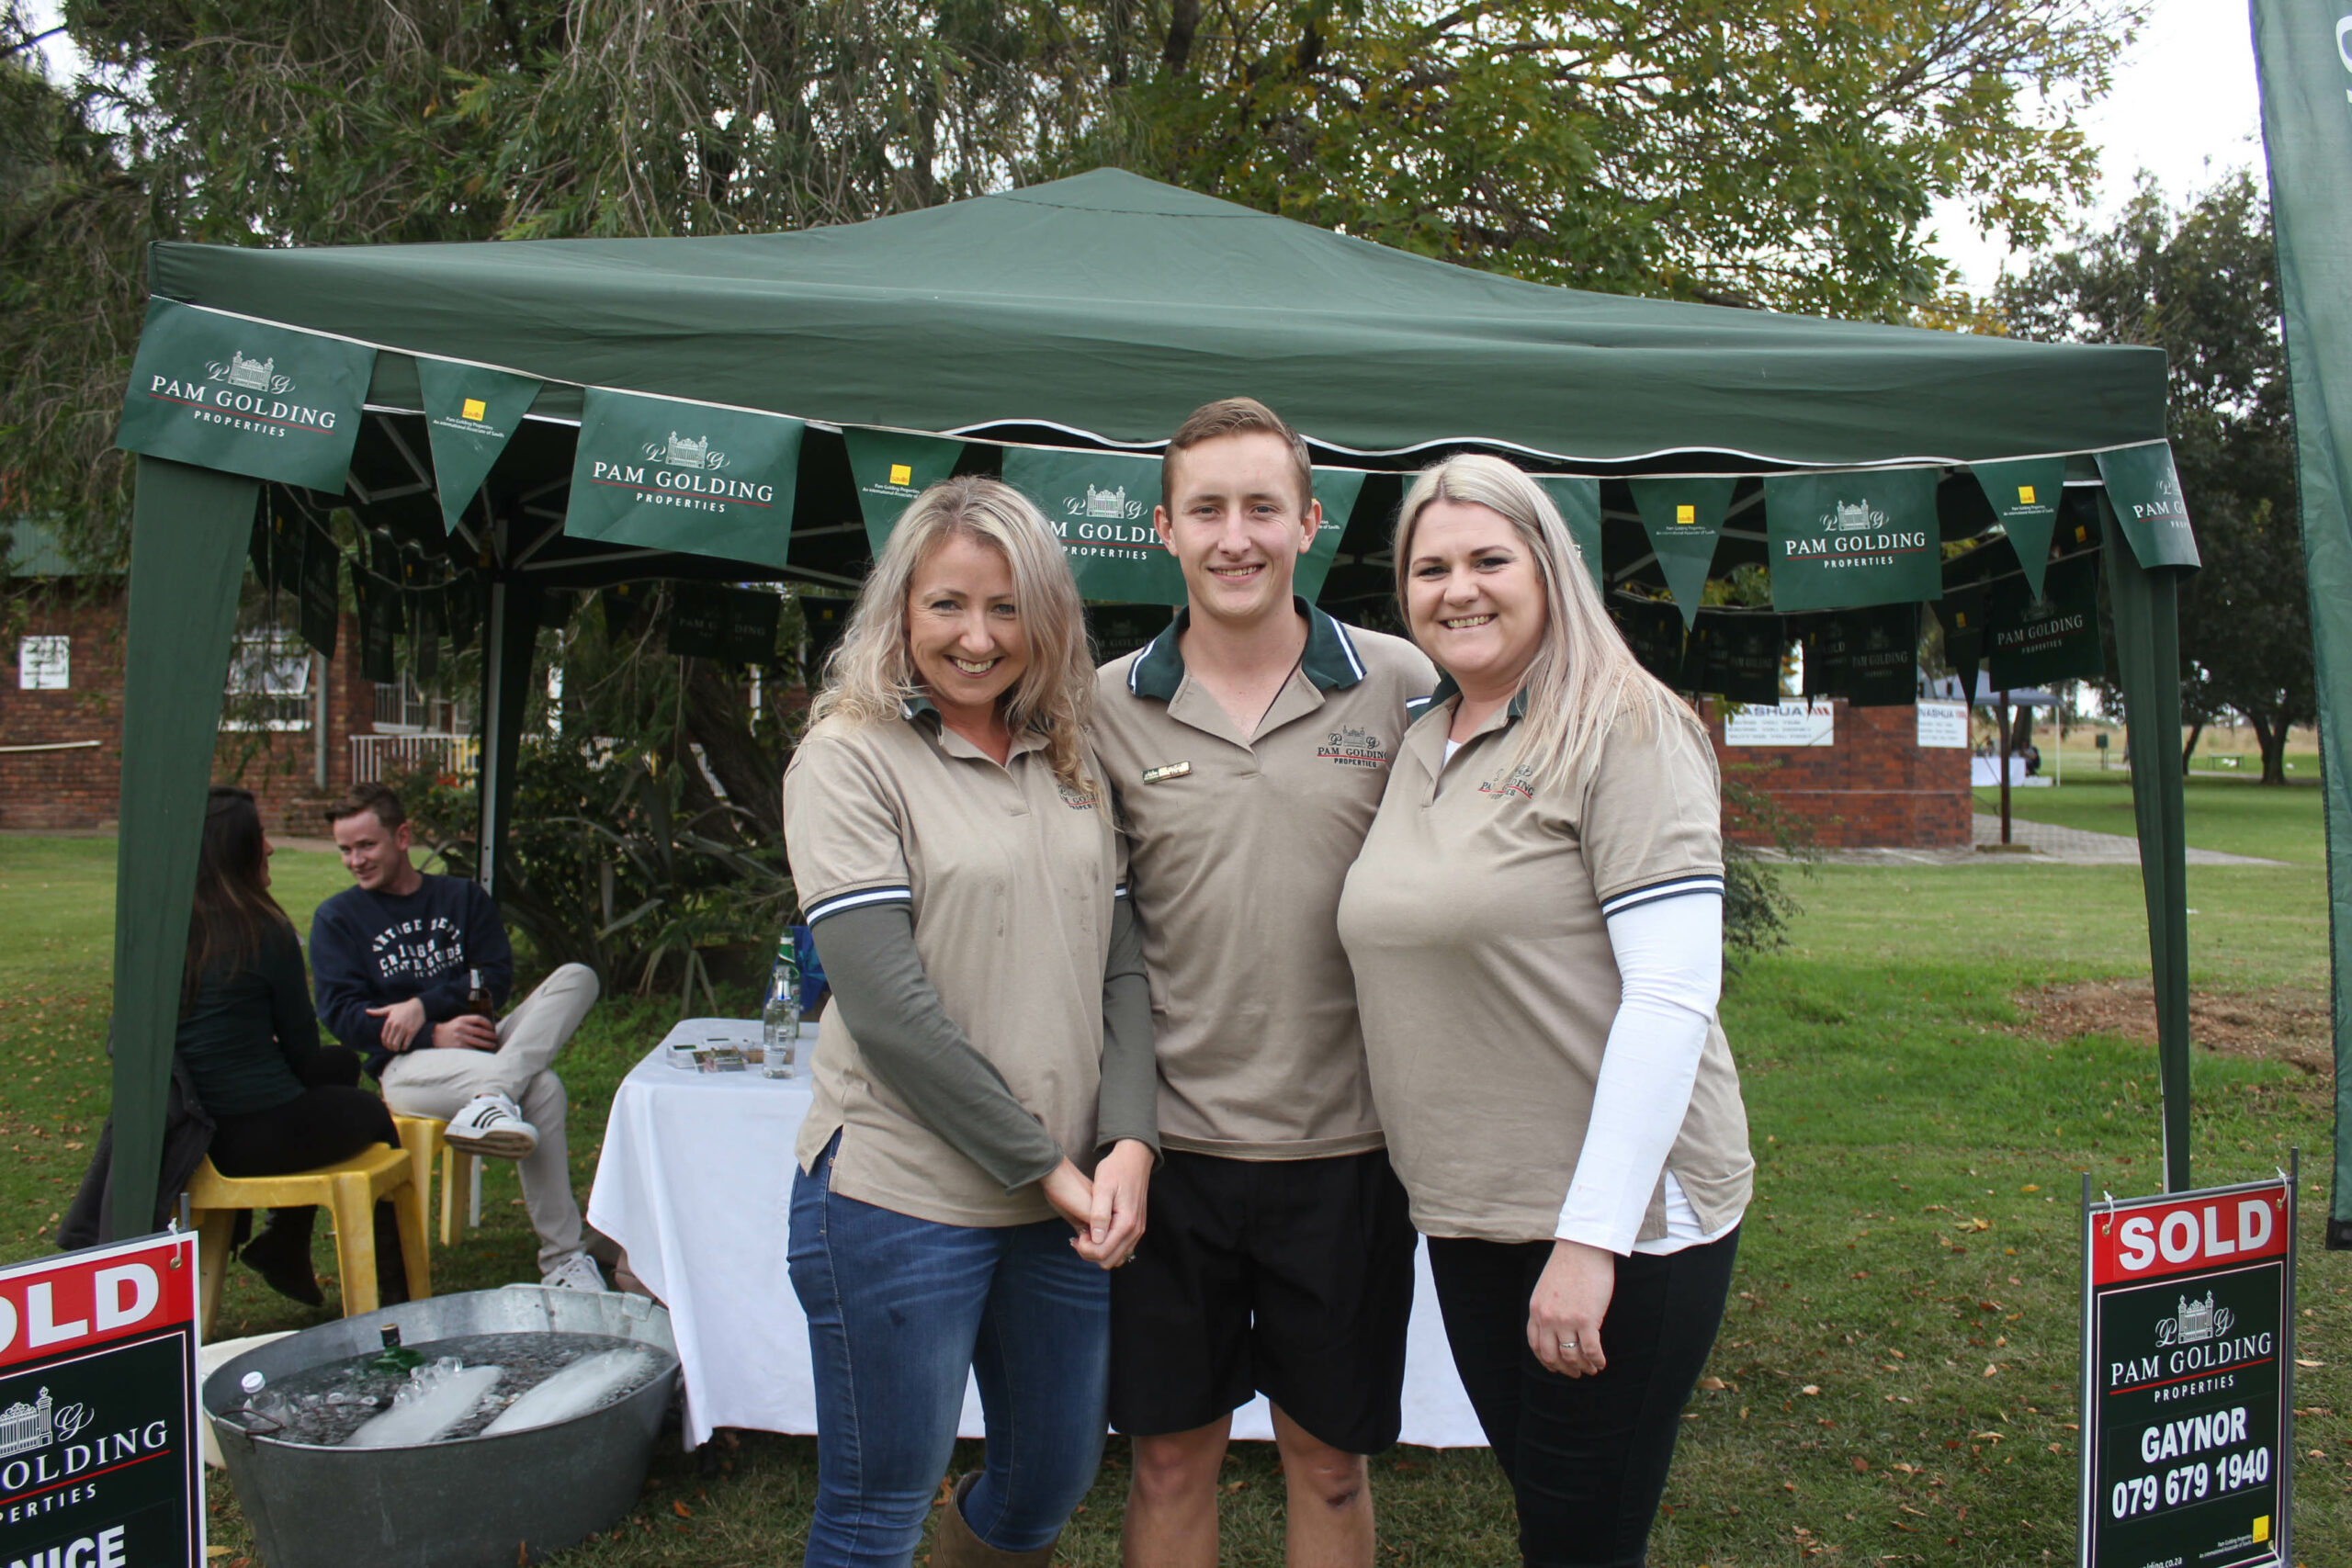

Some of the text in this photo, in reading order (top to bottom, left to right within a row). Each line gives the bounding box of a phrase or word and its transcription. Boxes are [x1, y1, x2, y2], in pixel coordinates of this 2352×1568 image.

[151, 375, 336, 429] PAM GOLDING
[194, 411, 286, 437] PROPERTIES
[593, 461, 774, 502] PAM GOLDING
[636, 492, 726, 513] PROPERTIES
[2132, 501, 2170, 518] PAM
[1079, 523, 1164, 545] GOLDI
[1785, 532, 1926, 556] PAM GOLDING
[1063, 547, 1148, 560] PROPERTIES
[1824, 556, 1894, 569] PROPERTIES
[1997, 614, 2084, 646] PAM GOLDING
[1738, 706, 1803, 716] ASHUA
[1317, 747, 1340, 755] PAM
[1334, 758, 1376, 767] PROPERTIES
[1481, 782, 1492, 790] PA
[2119, 1200, 2272, 1270] SOLD
[2111, 1332, 2271, 1386] PAM GOLDING
[2154, 1375, 2234, 1403] PROPERTIES
[2141, 1407, 2246, 1463] GAYNOR
[2, 1420, 168, 1490] OLDING
[2113, 1447, 2268, 1518] 079 679 1940
[0, 1483, 96, 1523] ERTIES
